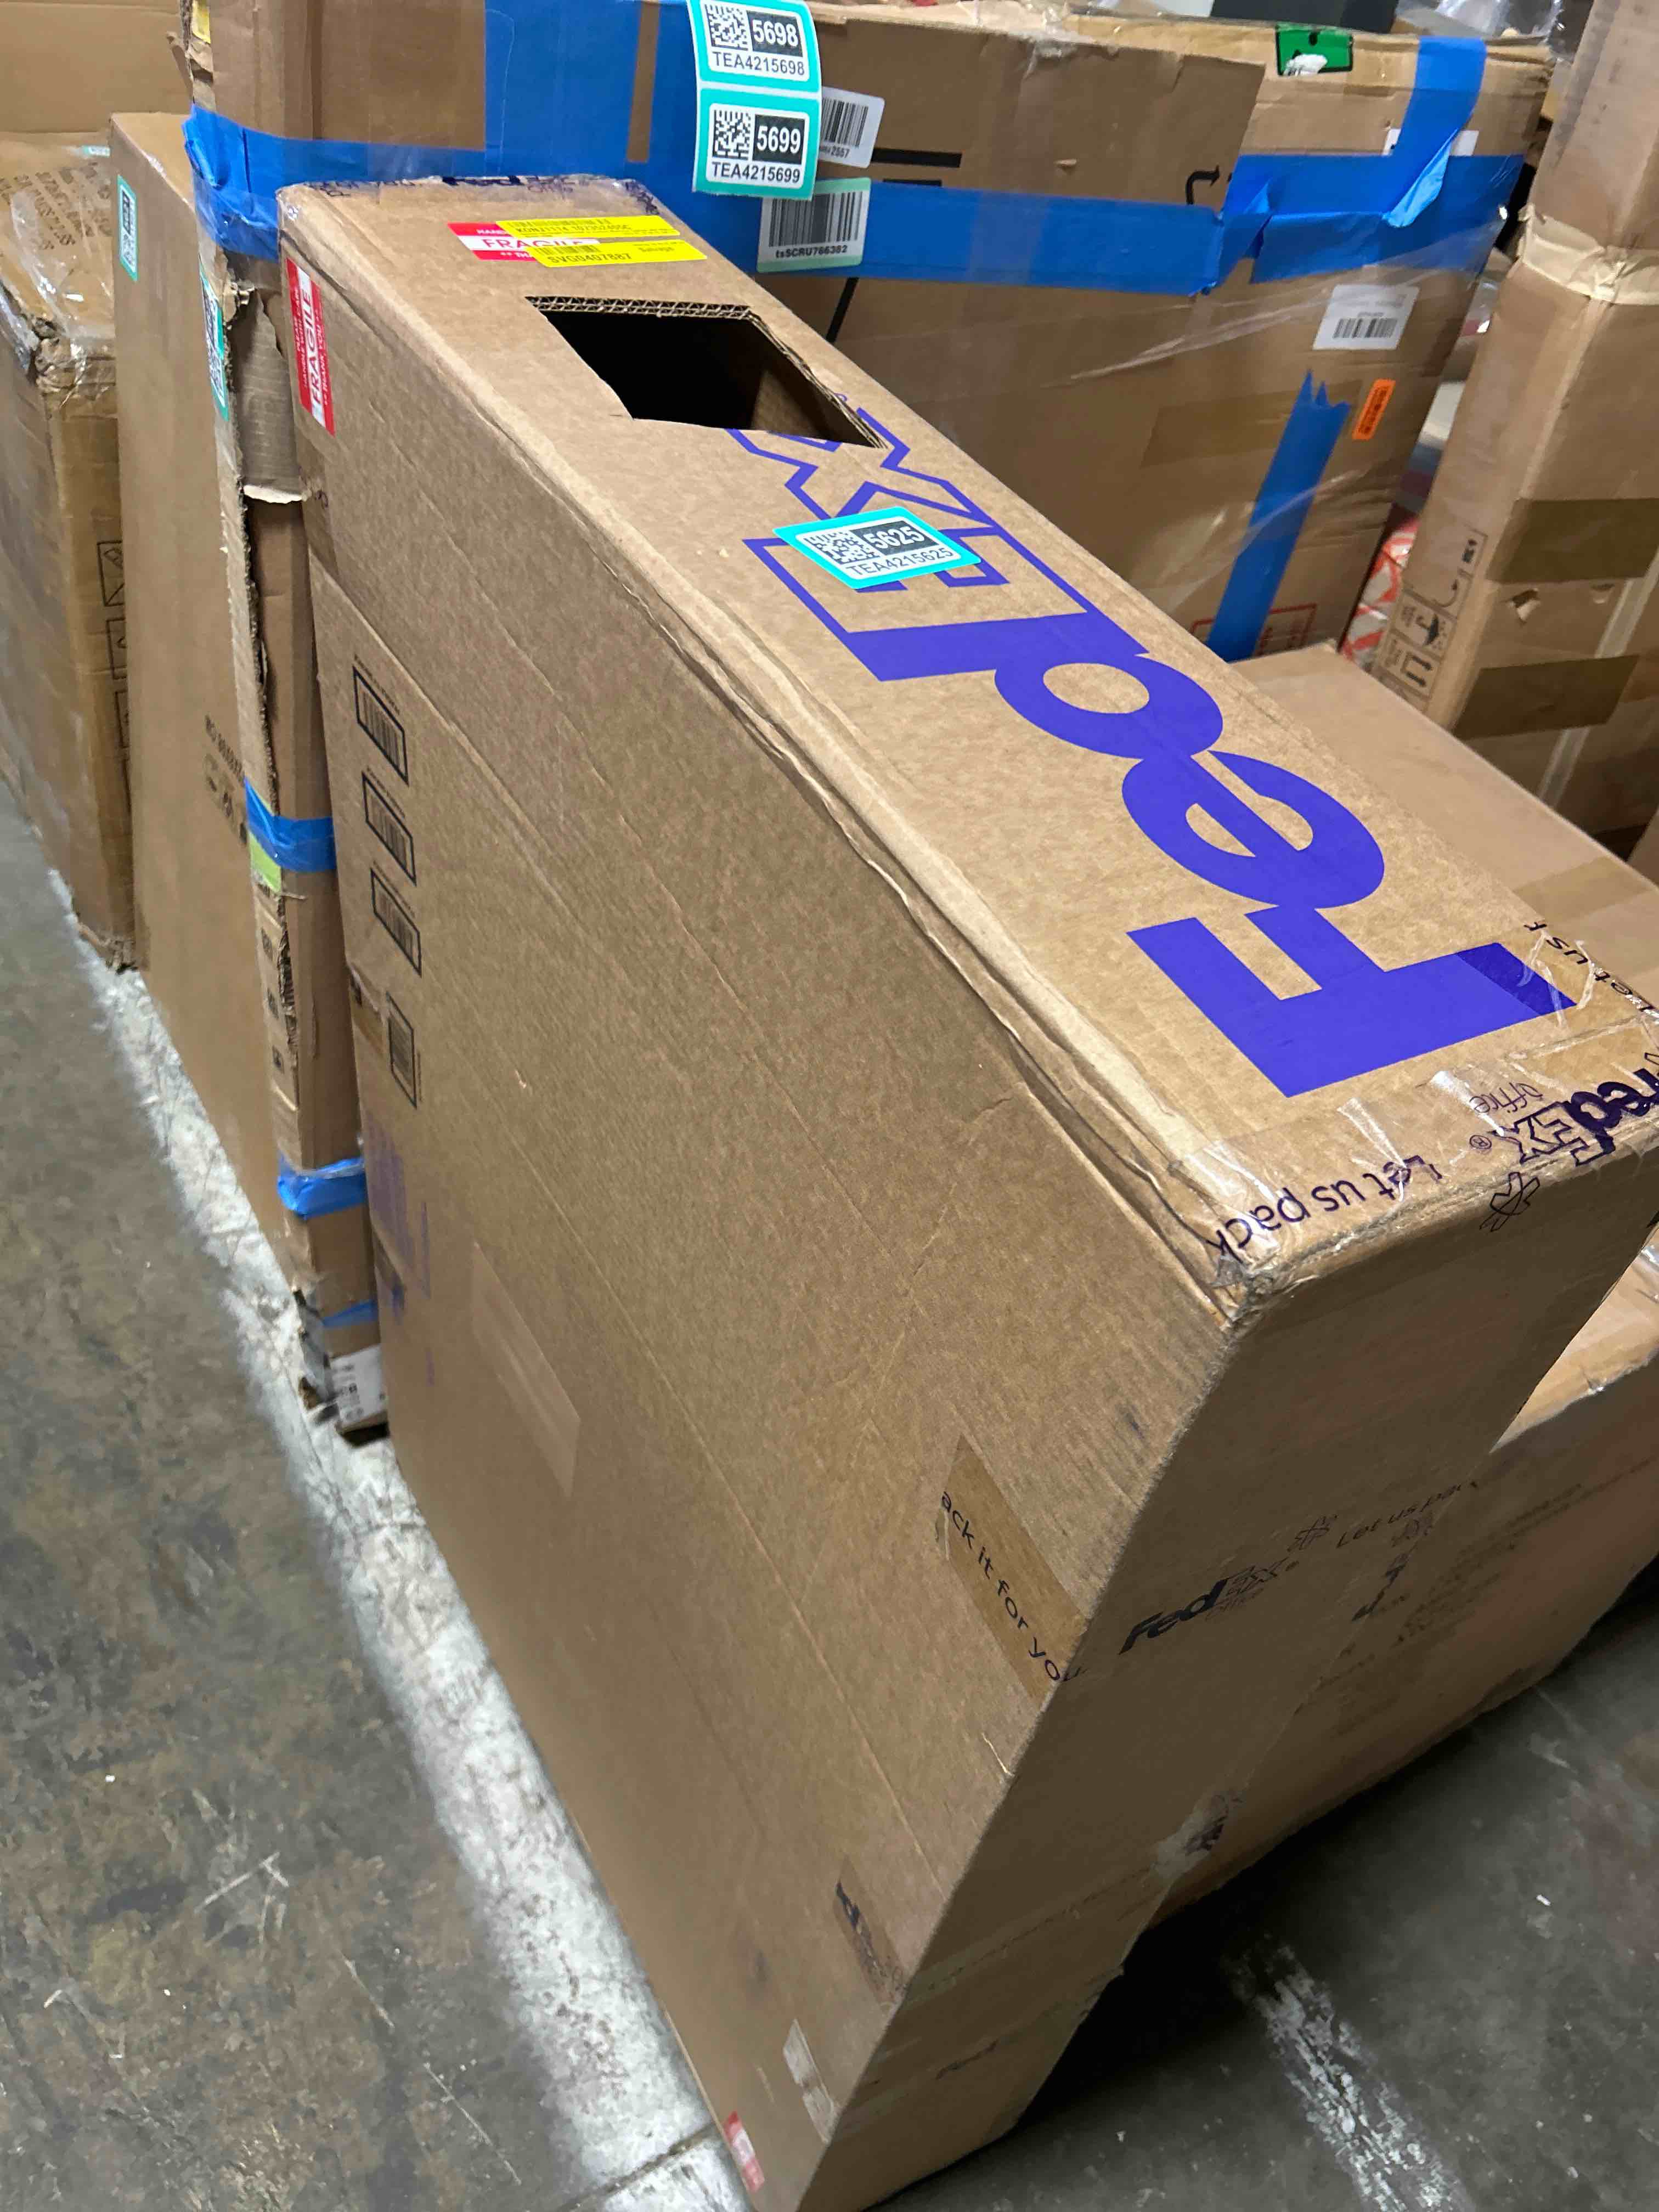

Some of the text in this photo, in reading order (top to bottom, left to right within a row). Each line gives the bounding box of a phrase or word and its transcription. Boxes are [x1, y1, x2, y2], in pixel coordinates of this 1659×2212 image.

[752, 20, 799, 47] 5698
[712, 51, 805, 76] TEA4215698
[757, 125, 801, 154] 5699
[712, 161, 800, 183] TEA4215699
[303, 291, 321, 405] FRAGILE
[864, 527, 926, 550] 5625
[845, 547, 954, 576] TEA4215625
[1206, 1155, 1443, 1264] Let us pack
[978, 1546, 994, 1580] it
[997, 1579, 1029, 1629] for
